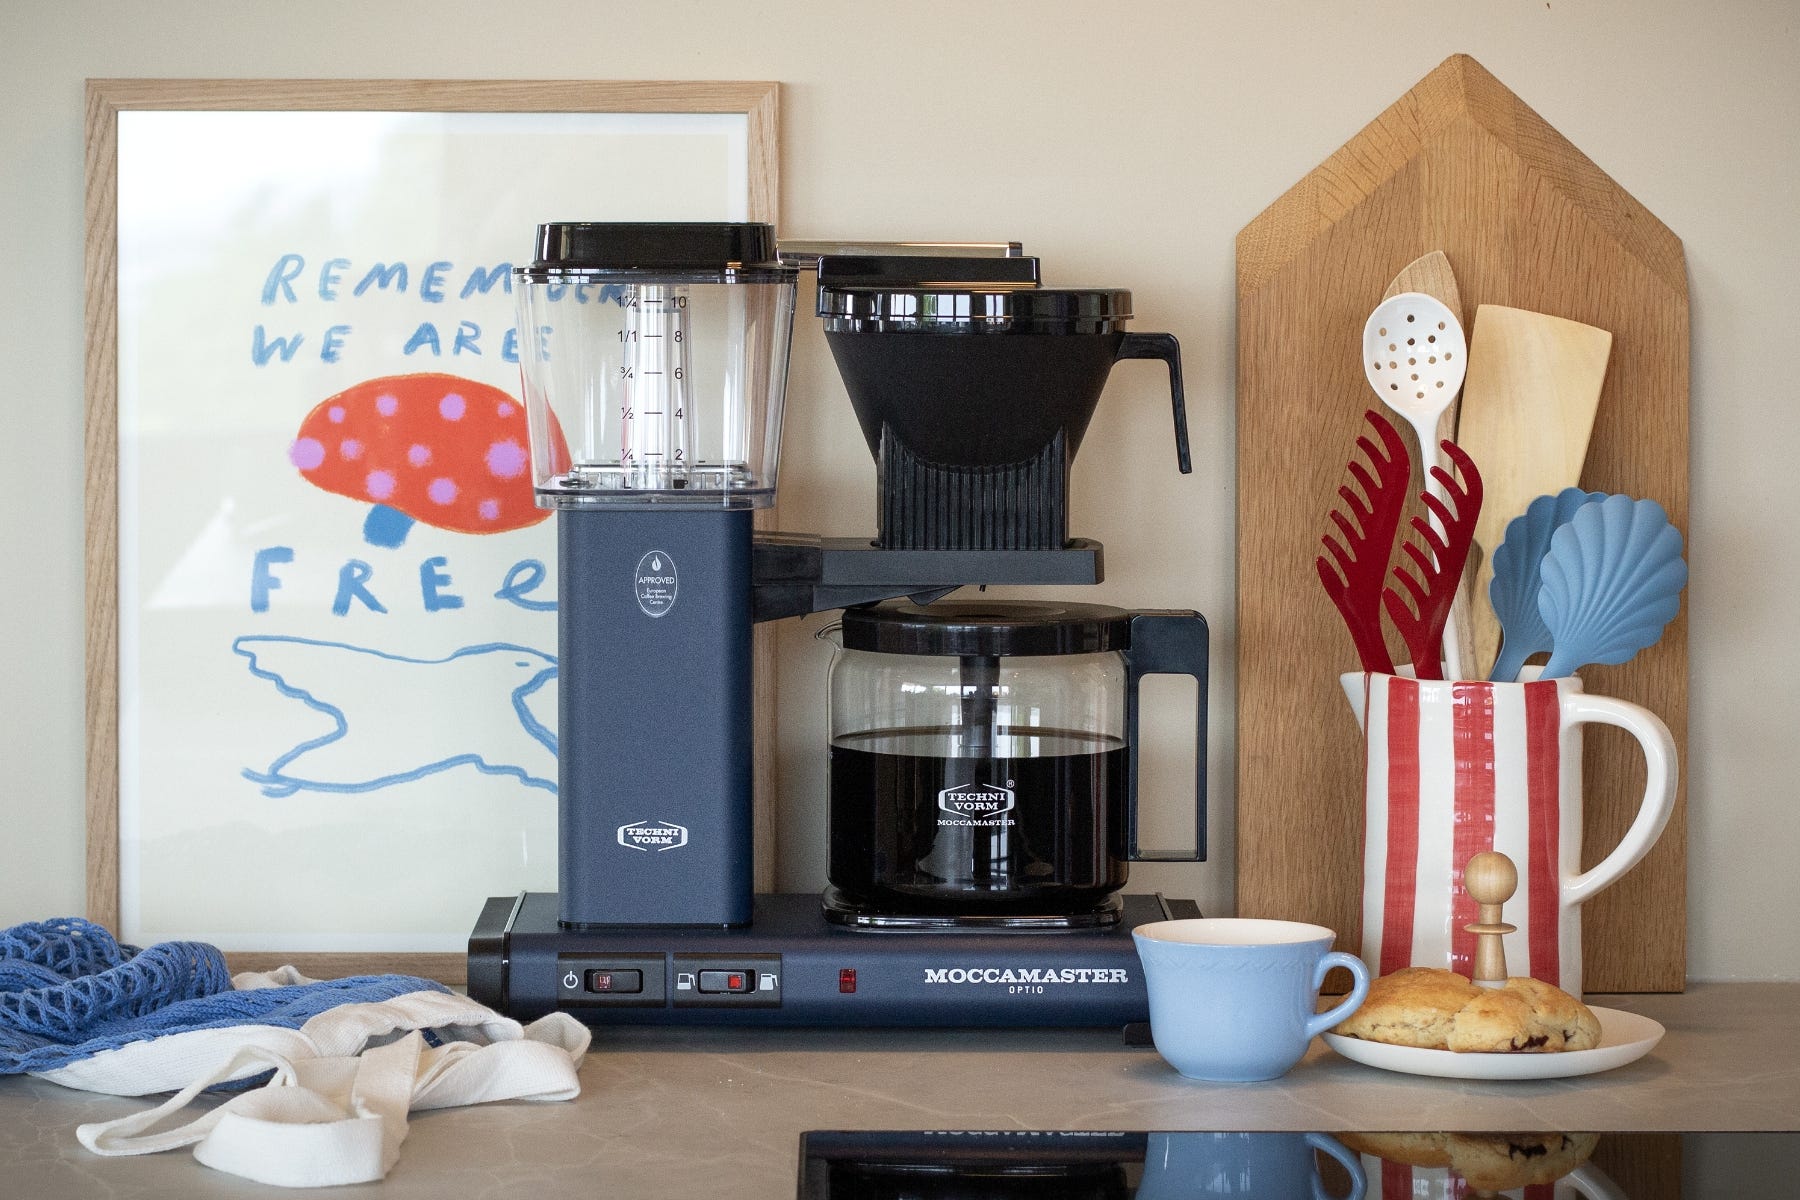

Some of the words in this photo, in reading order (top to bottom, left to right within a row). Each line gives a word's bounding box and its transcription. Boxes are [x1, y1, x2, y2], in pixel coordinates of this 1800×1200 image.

[671, 296, 687, 308] 10
[617, 330, 638, 342] 1/1
[674, 330, 683, 342] 8
[252, 324, 353, 367] WE
[674, 368, 683, 379] 6
[674, 408, 683, 419] 4
[675, 449, 683, 460] 2
[948, 792, 1006, 801] TECHNI
[954, 802, 999, 810] VORM
[626, 828, 679, 836] TECHNI
[632, 836, 673, 844] VORM
[924, 968, 1129, 984] MOCCAMASTER
[1009, 985, 1044, 994] OPTIO
